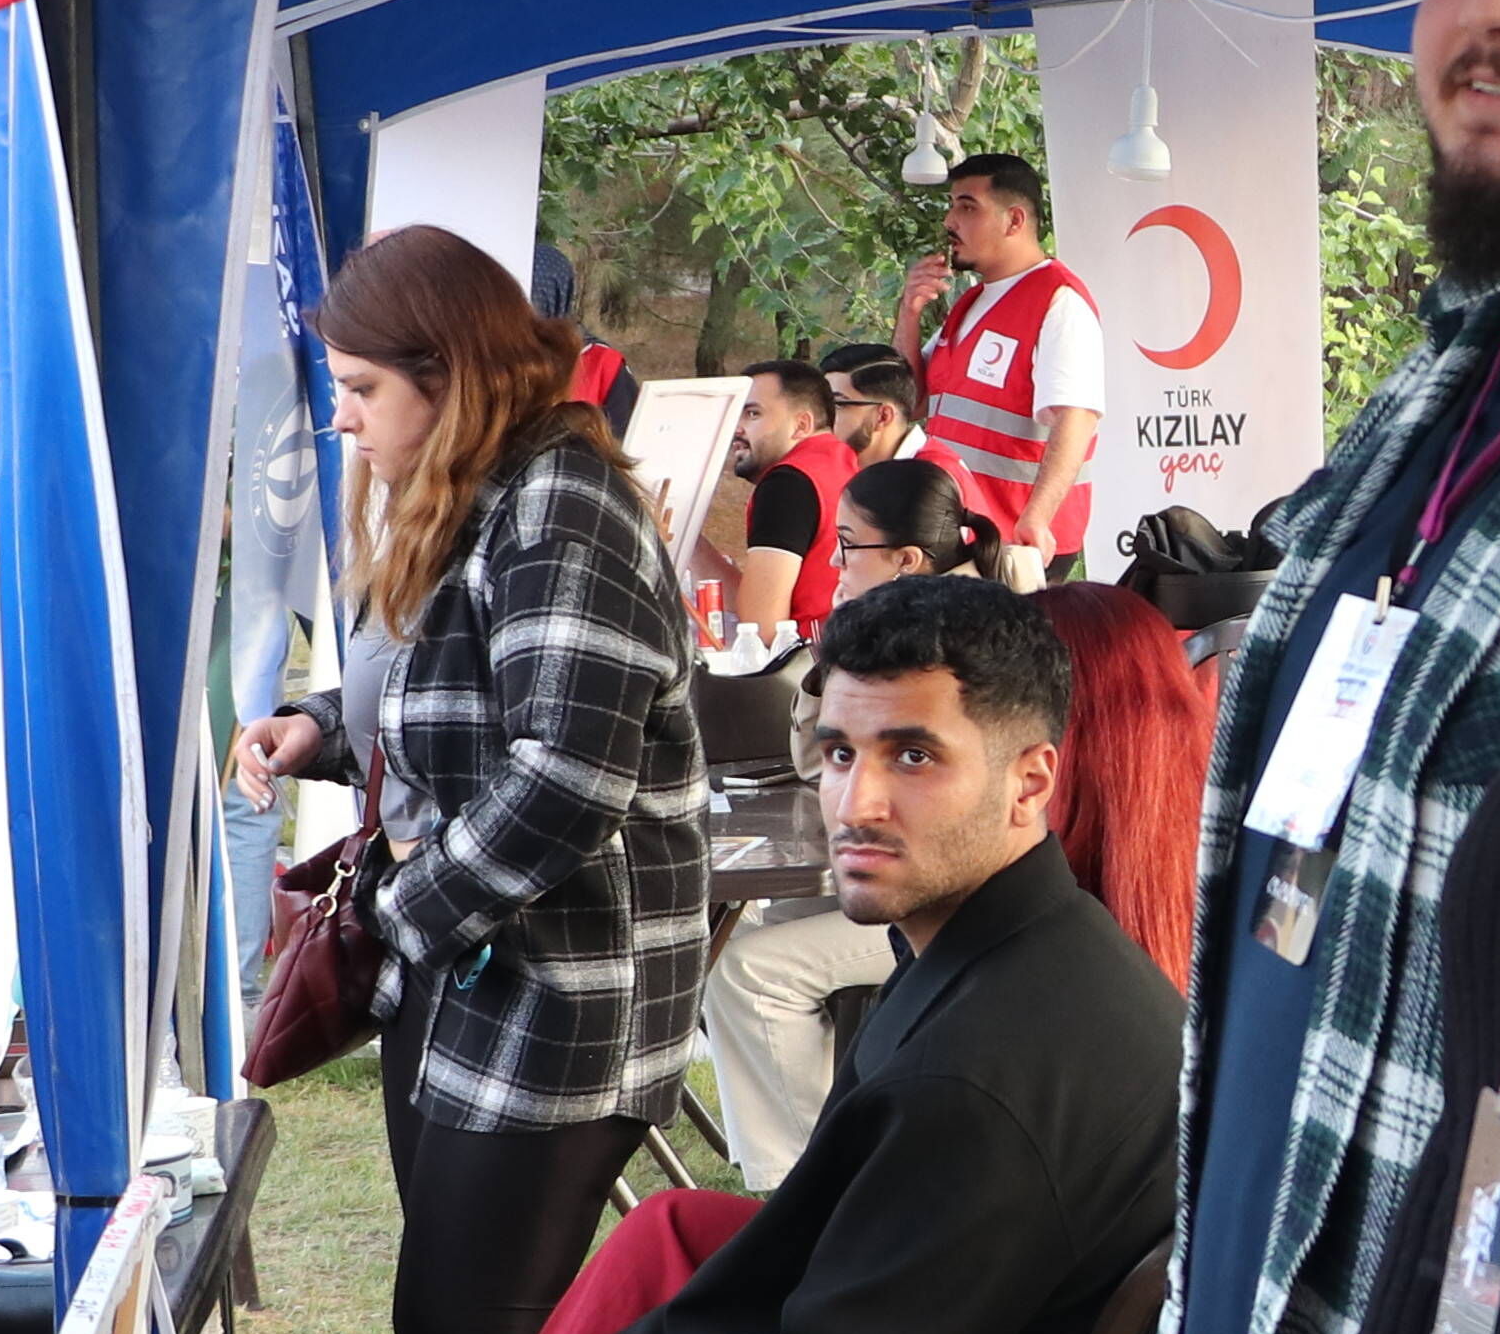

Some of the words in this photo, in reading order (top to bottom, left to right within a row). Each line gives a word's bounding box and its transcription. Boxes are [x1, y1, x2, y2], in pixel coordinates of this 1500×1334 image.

[1164, 385, 1213, 408] TÜRK
[1136, 413, 1247, 447] KIZILAY
[1159, 452, 1224, 493] genç
